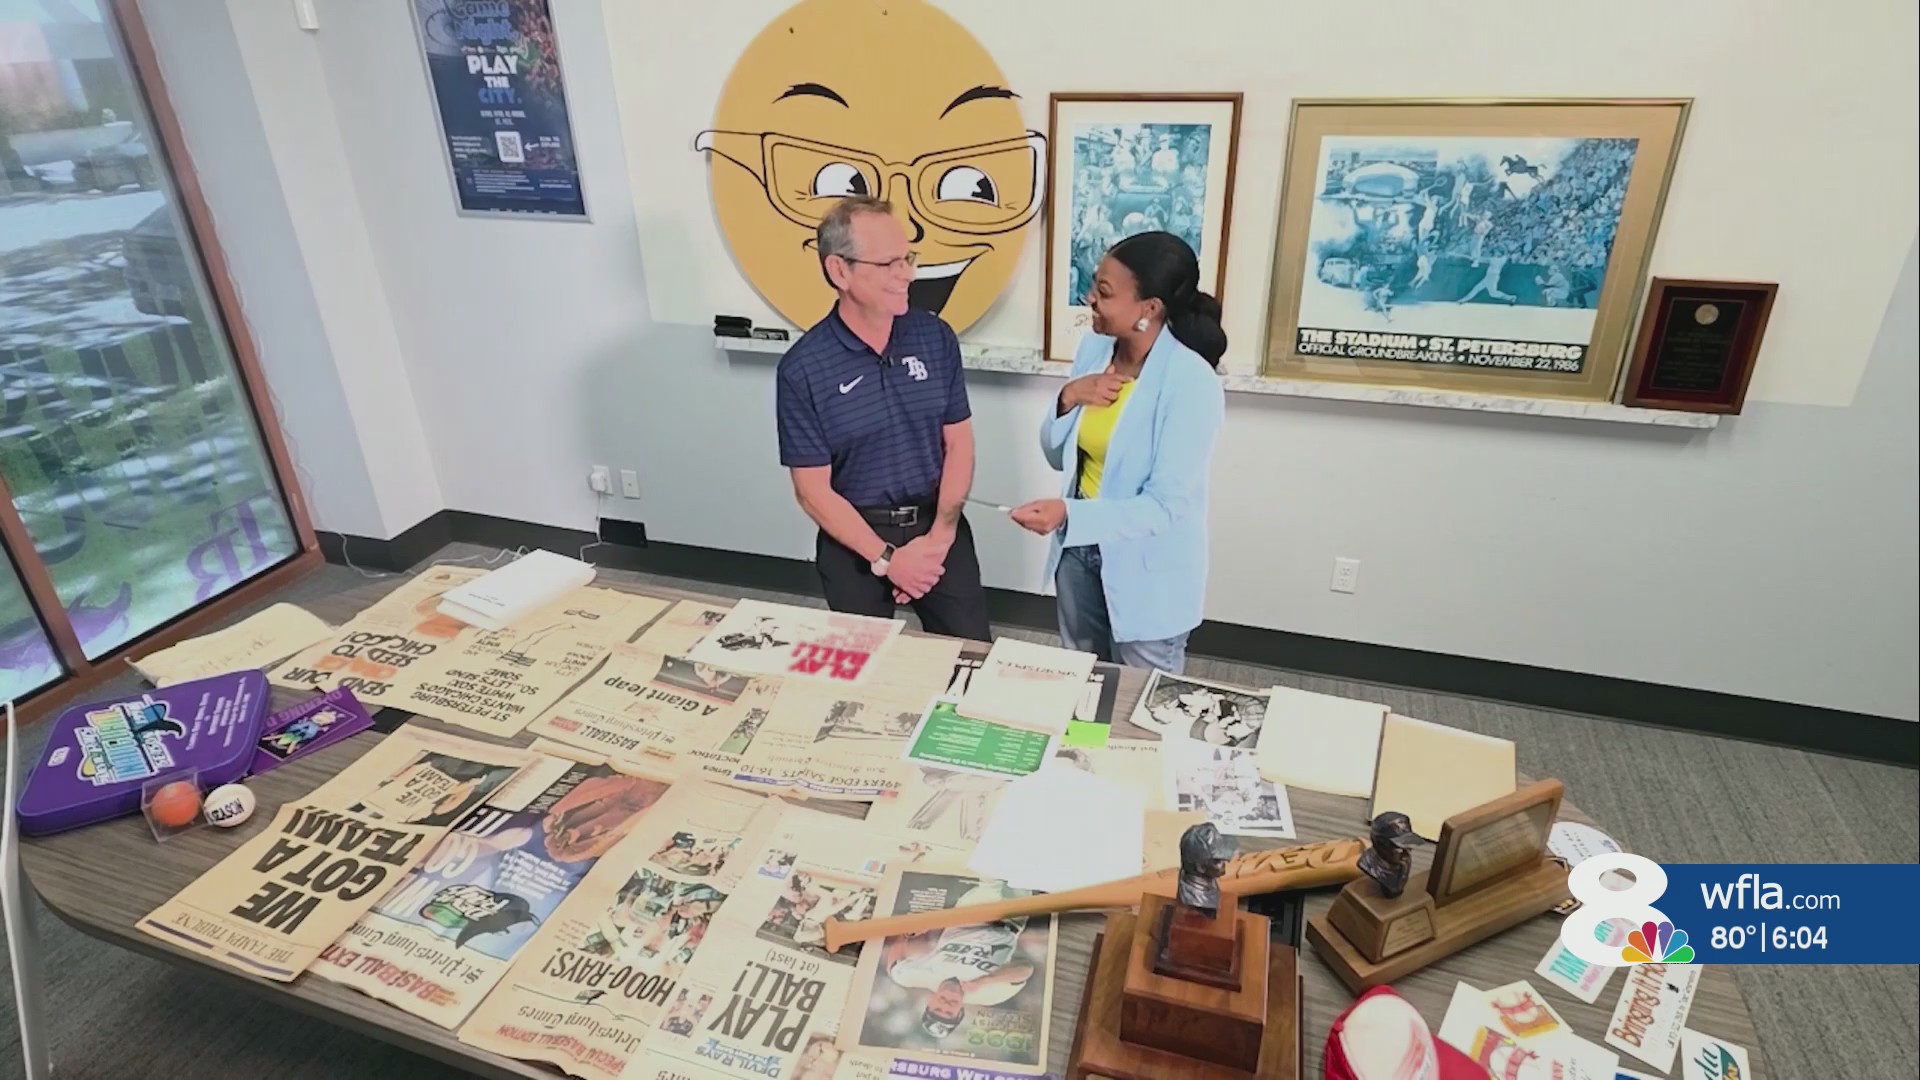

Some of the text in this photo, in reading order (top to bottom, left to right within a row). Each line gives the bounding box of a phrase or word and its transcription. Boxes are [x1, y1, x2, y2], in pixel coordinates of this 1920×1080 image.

[466, 55, 518, 74] PLAY
[484, 76, 509, 88] THE
[1298, 344, 1345, 356] OFFICIAL
[1347, 346, 1454, 363] GROUNDBREAKING
[1467, 354, 1533, 369] NOVEMBER
[1300, 329, 1582, 359] THE STADIUM ST. PETERSBURG
[901, 356, 928, 381] TB
[332, 645, 419, 667] SEED TO
[340, 631, 437, 656] CHICAGO!
[791, 641, 870, 664] BALL!
[282, 667, 332, 684] OUR
[788, 657, 858, 680] PLAY
[338, 676, 394, 696] SEND
[478, 685, 516, 701] WHITE
[604, 676, 719, 717] A Giant leap
[410, 691, 491, 718] PETERSBURG
[482, 698, 526, 714] WANTS
[580, 725, 640, 750] BASEBALL
[416, 767, 451, 791] TEAM!
[740, 763, 773, 776] 16-10
[829, 776, 861, 787] EDGE
[396, 791, 421, 808] WE
[405, 778, 441, 800] GOT A
[282, 804, 425, 865] TEAM!
[252, 838, 300, 873] A
[282, 851, 388, 902] GOT
[231, 881, 323, 935] WE
[383, 932, 465, 977] Petersburg
[765, 948, 820, 975] (at last)
[319, 943, 439, 999] BASEBALL EXT
[541, 947, 677, 1007] HOOO-RAYS!
[733, 959, 826, 1014] BALL!
[518, 1006, 563, 1029] Times
[707, 997, 810, 1053] PLAY
[1612, 987, 1660, 1048] Bringing
[497, 1024, 626, 1076] SPECIAL BASEBALL EDITION
[696, 1046, 737, 1067] RAYS
[736, 1055, 780, 1079] DEVIL
